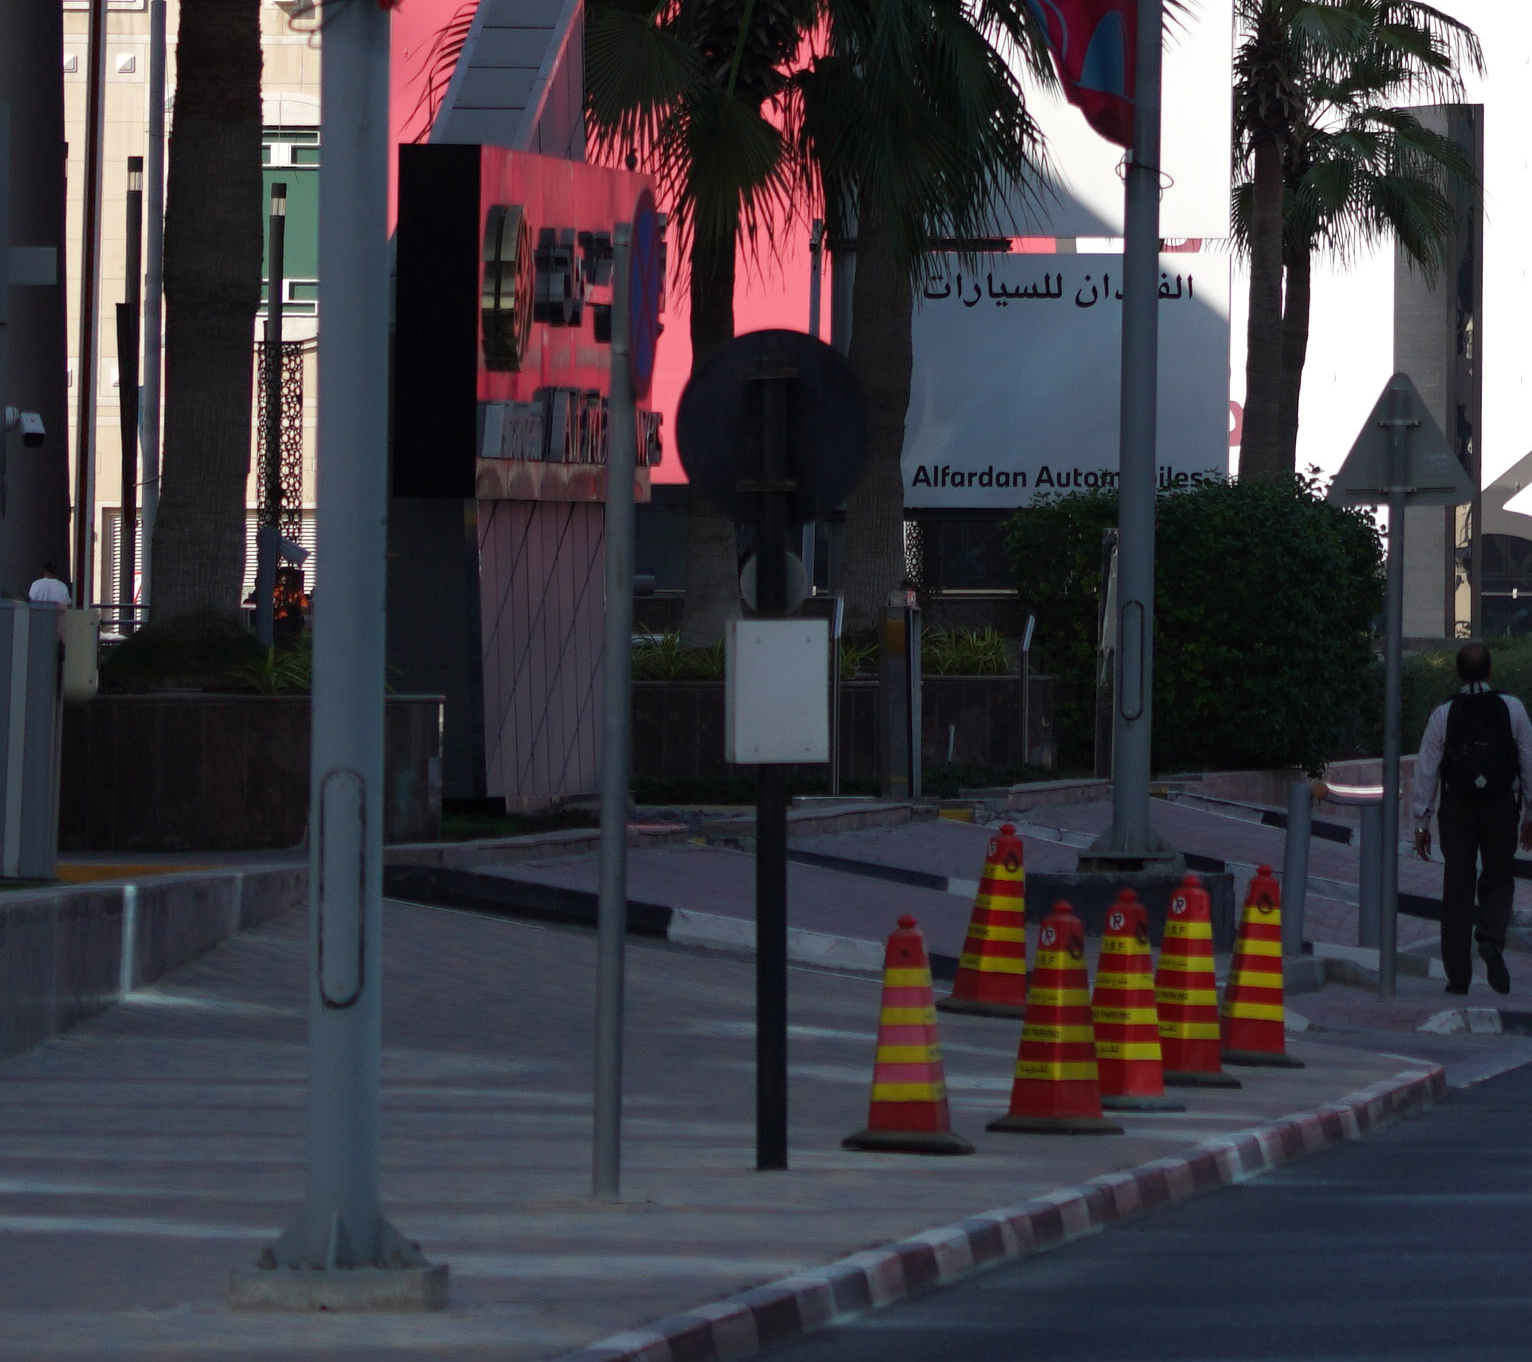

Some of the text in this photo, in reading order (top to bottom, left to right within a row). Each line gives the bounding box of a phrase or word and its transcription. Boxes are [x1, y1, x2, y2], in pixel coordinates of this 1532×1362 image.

[923, 273, 1063, 307] للسيارات
[911, 465, 1204, 488] Alfardan Automiles
